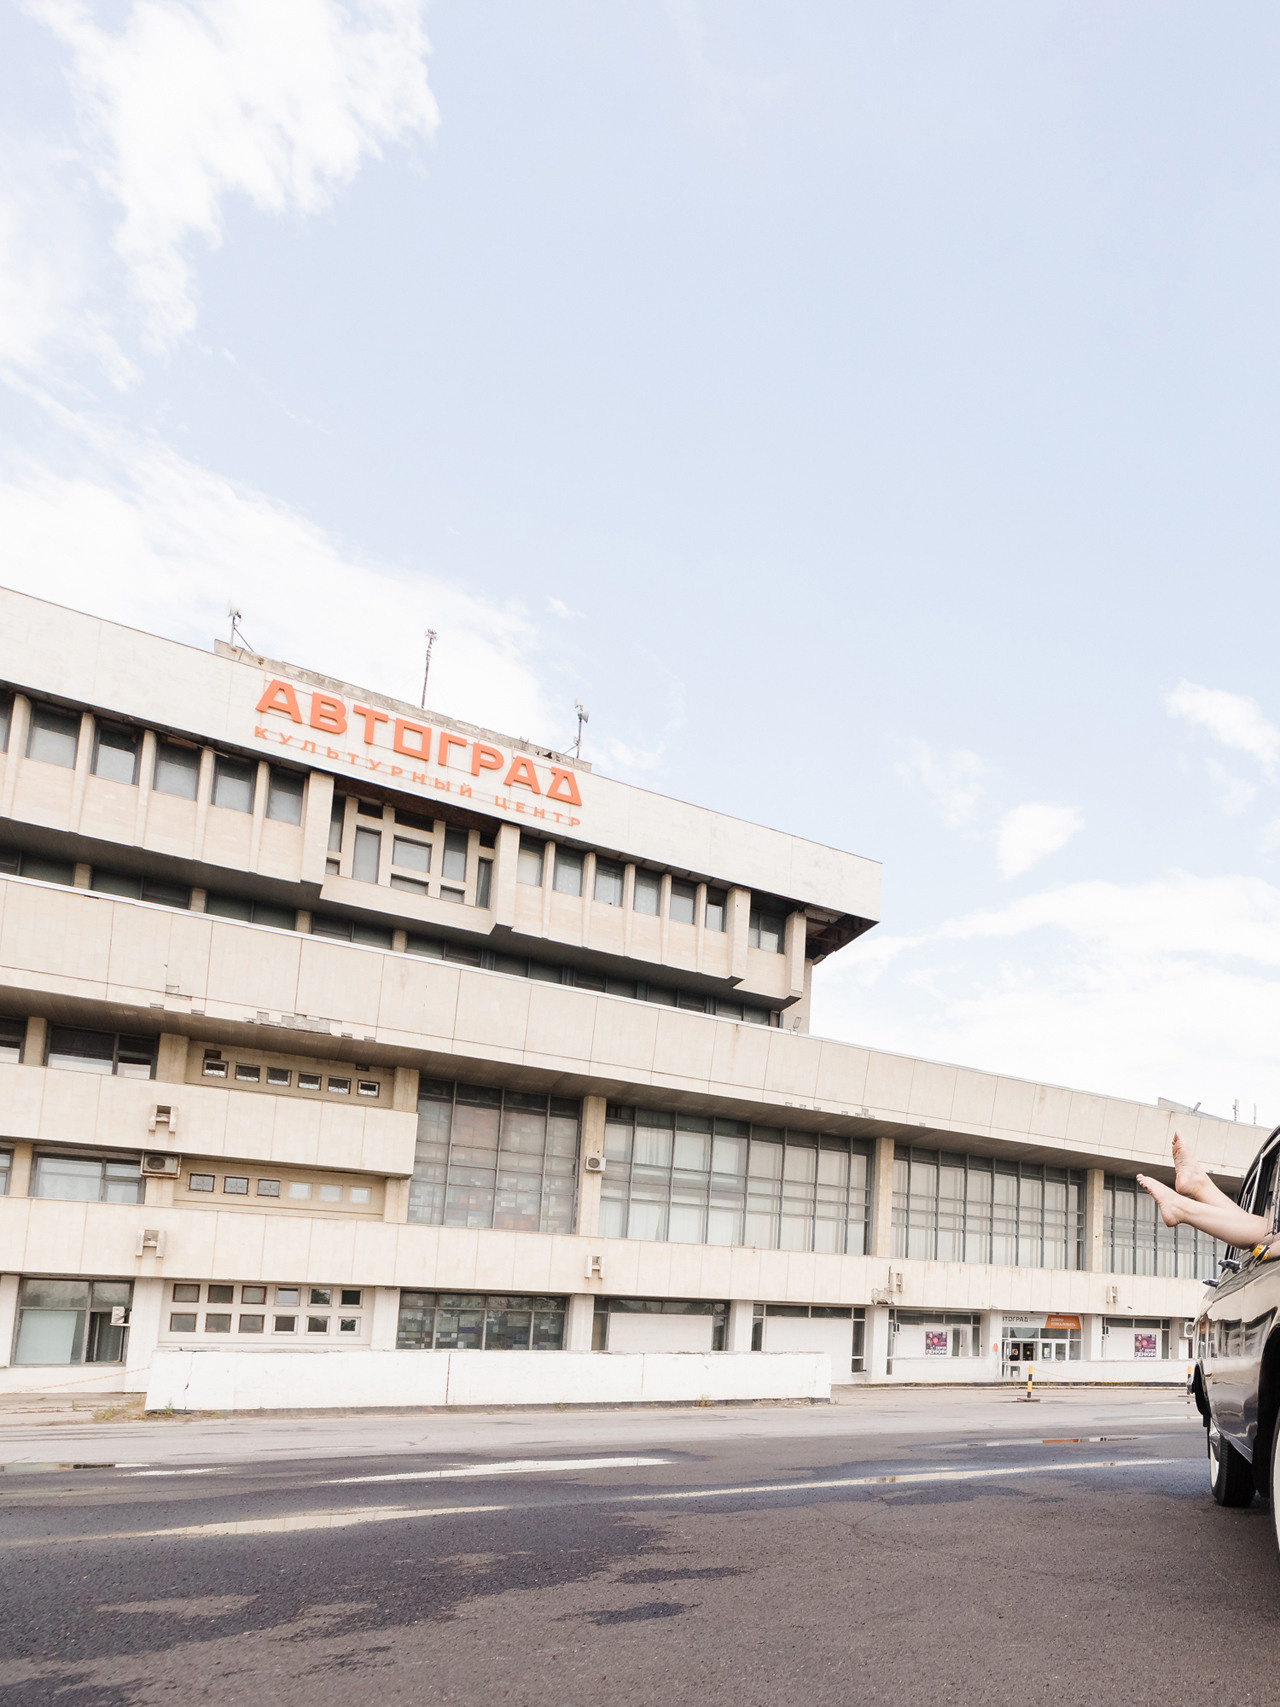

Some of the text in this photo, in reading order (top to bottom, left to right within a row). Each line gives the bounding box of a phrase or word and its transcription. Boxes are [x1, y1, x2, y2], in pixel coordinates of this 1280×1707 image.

[254, 725, 581, 826] КУЛЬТУРНЫЙ ЦЕНТР
[255, 678, 583, 806] АВТОГРАД
